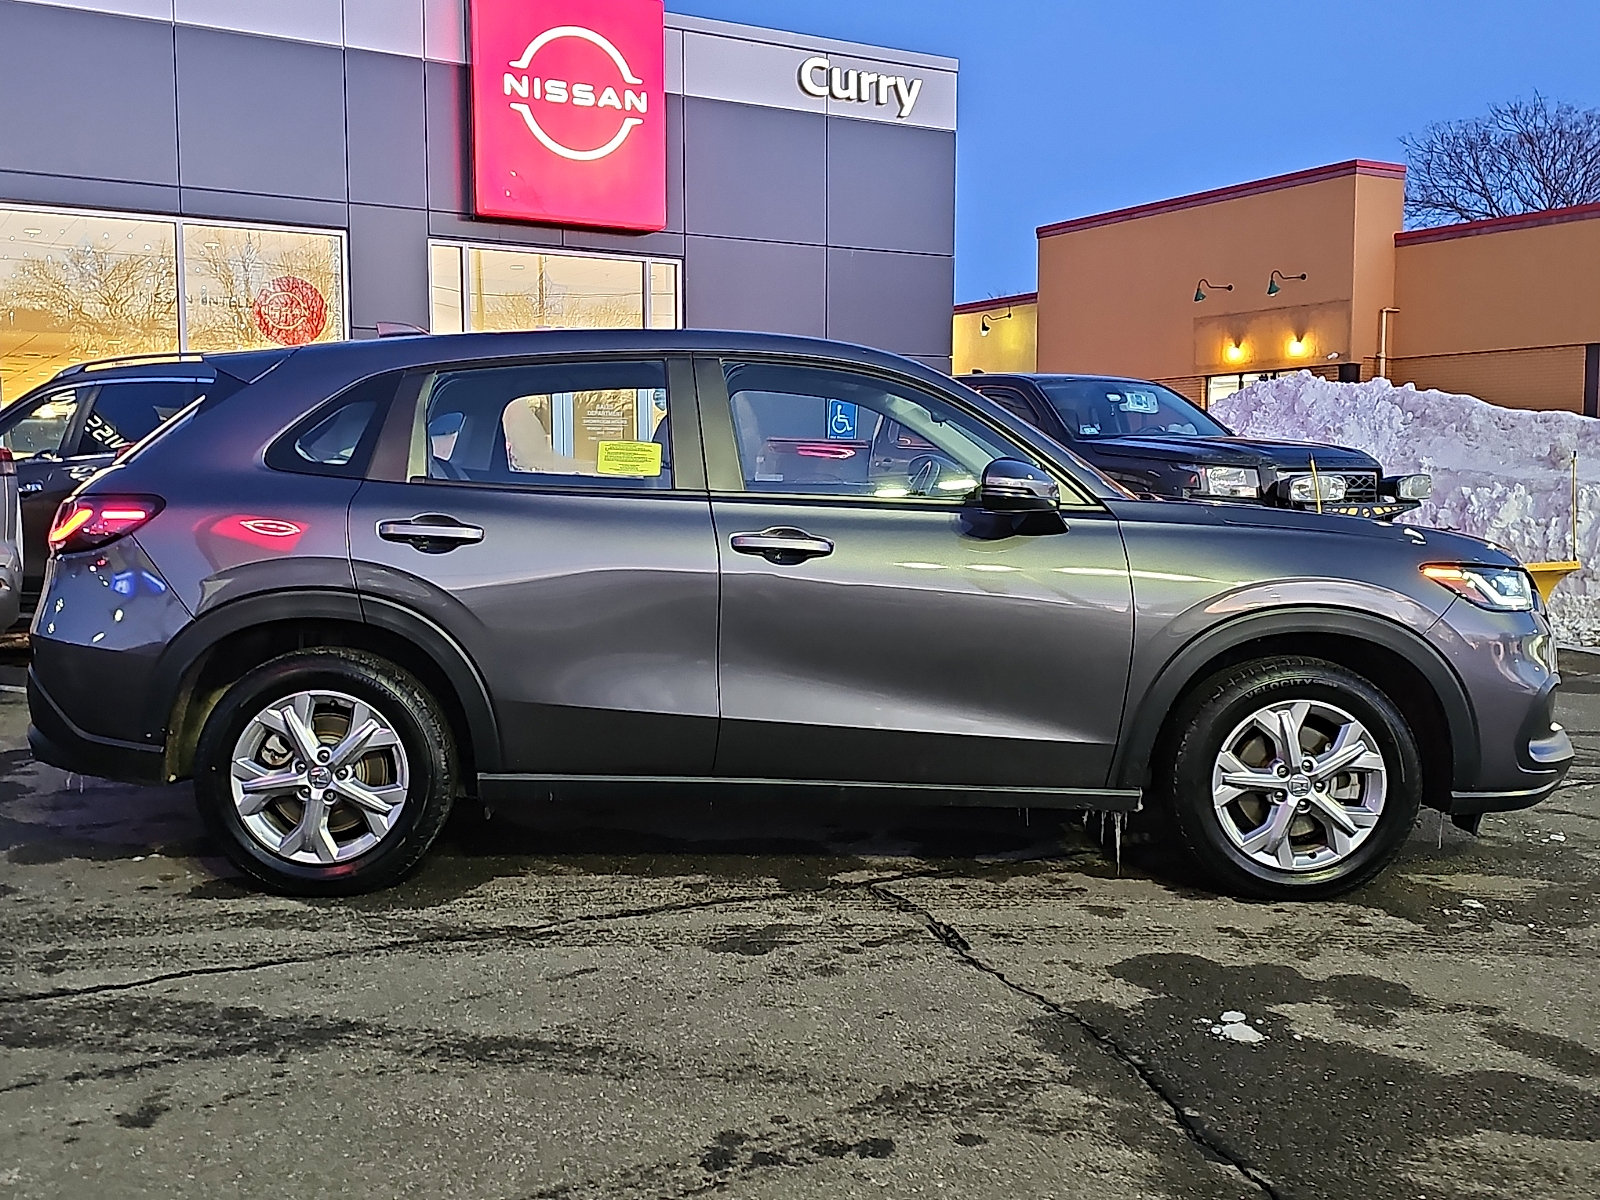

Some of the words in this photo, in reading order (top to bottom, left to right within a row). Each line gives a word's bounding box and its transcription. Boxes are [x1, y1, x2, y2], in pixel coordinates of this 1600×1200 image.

[503, 72, 648, 114] NISSAN
[797, 56, 923, 118] Curry
[1244, 678, 1313, 700] VELOCITY
